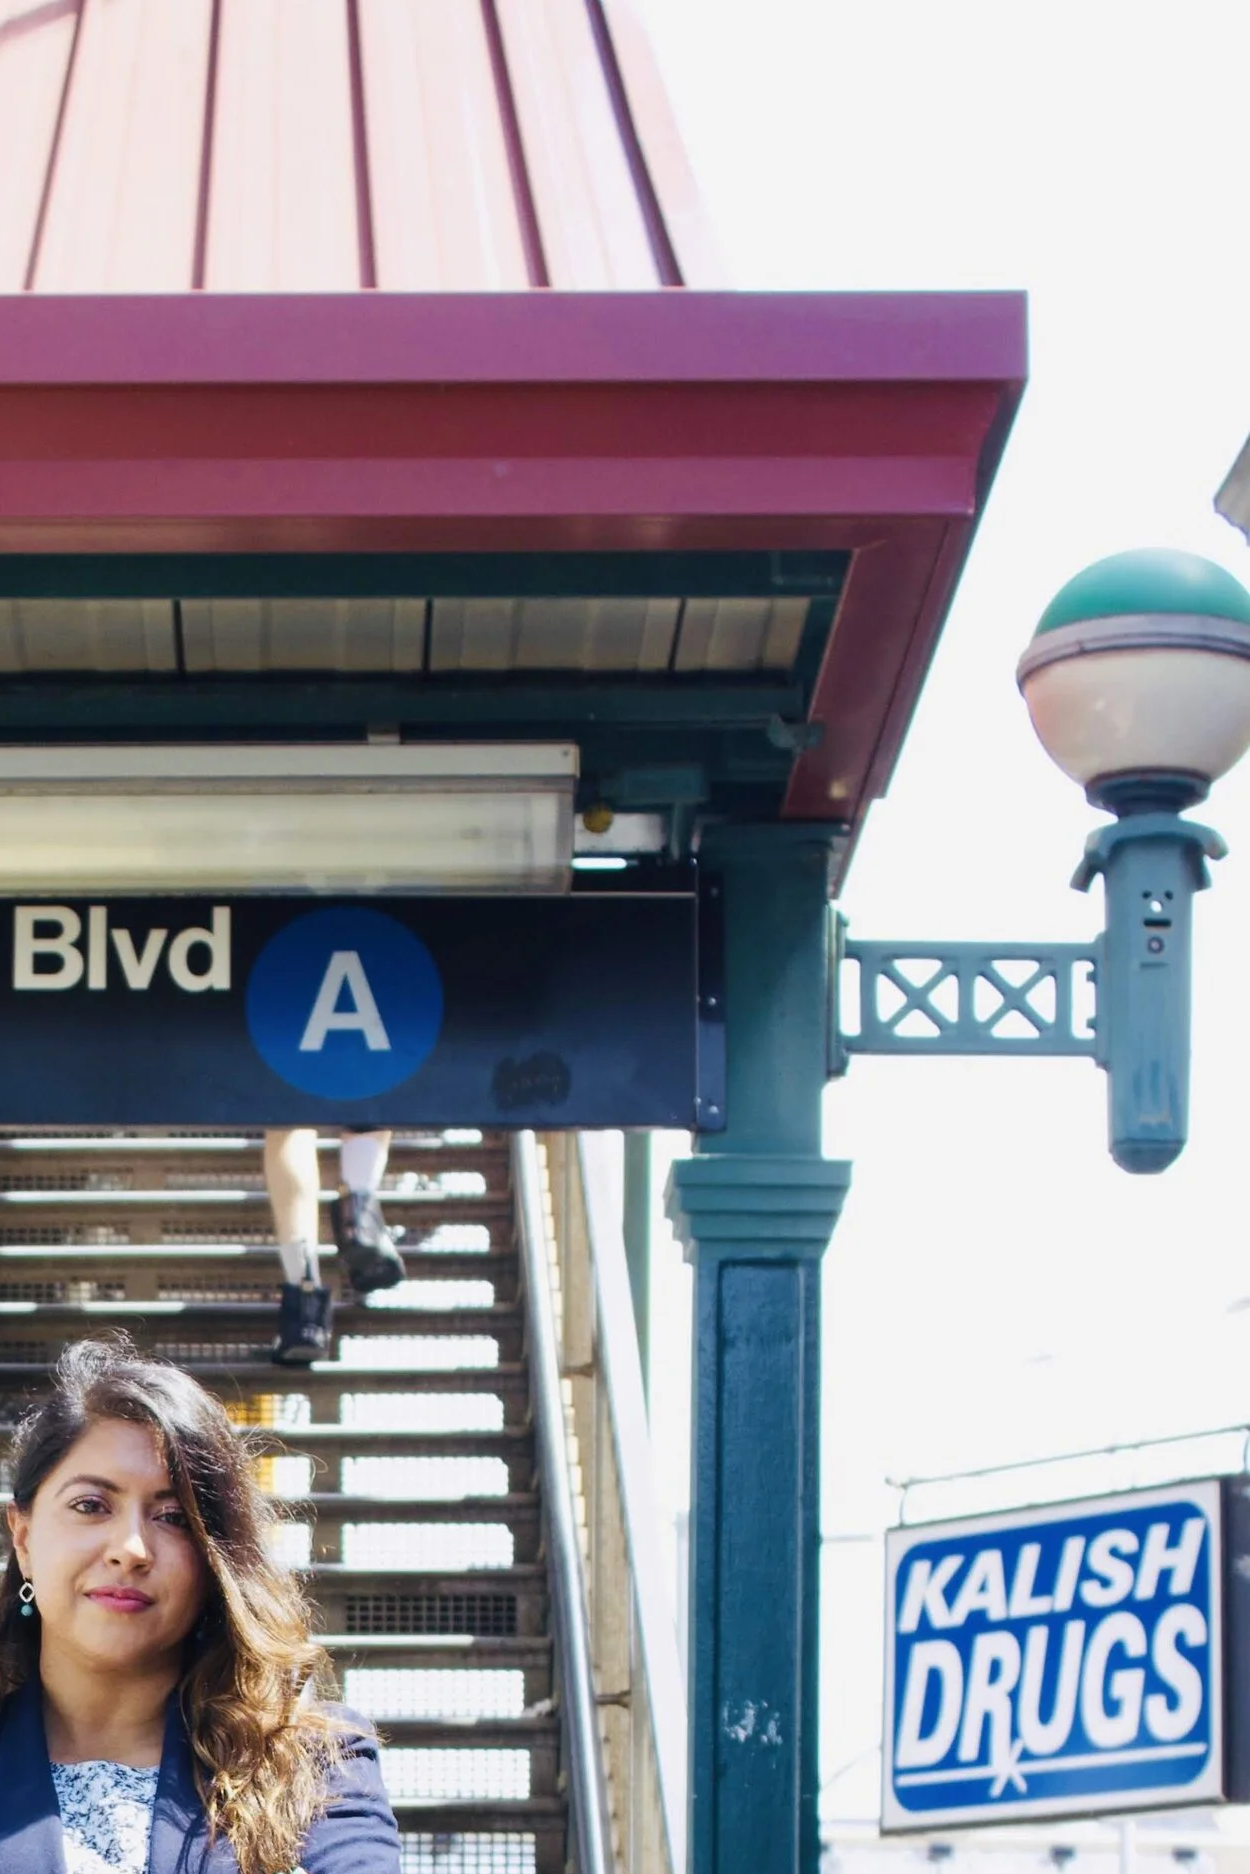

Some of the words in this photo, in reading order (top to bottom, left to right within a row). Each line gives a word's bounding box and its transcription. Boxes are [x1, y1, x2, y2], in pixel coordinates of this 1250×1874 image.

[13, 906, 231, 992] Blvd
[299, 951, 391, 1051] A
[897, 1517, 1207, 1634] KALISH
[895, 1602, 1208, 1797] DRUGS
